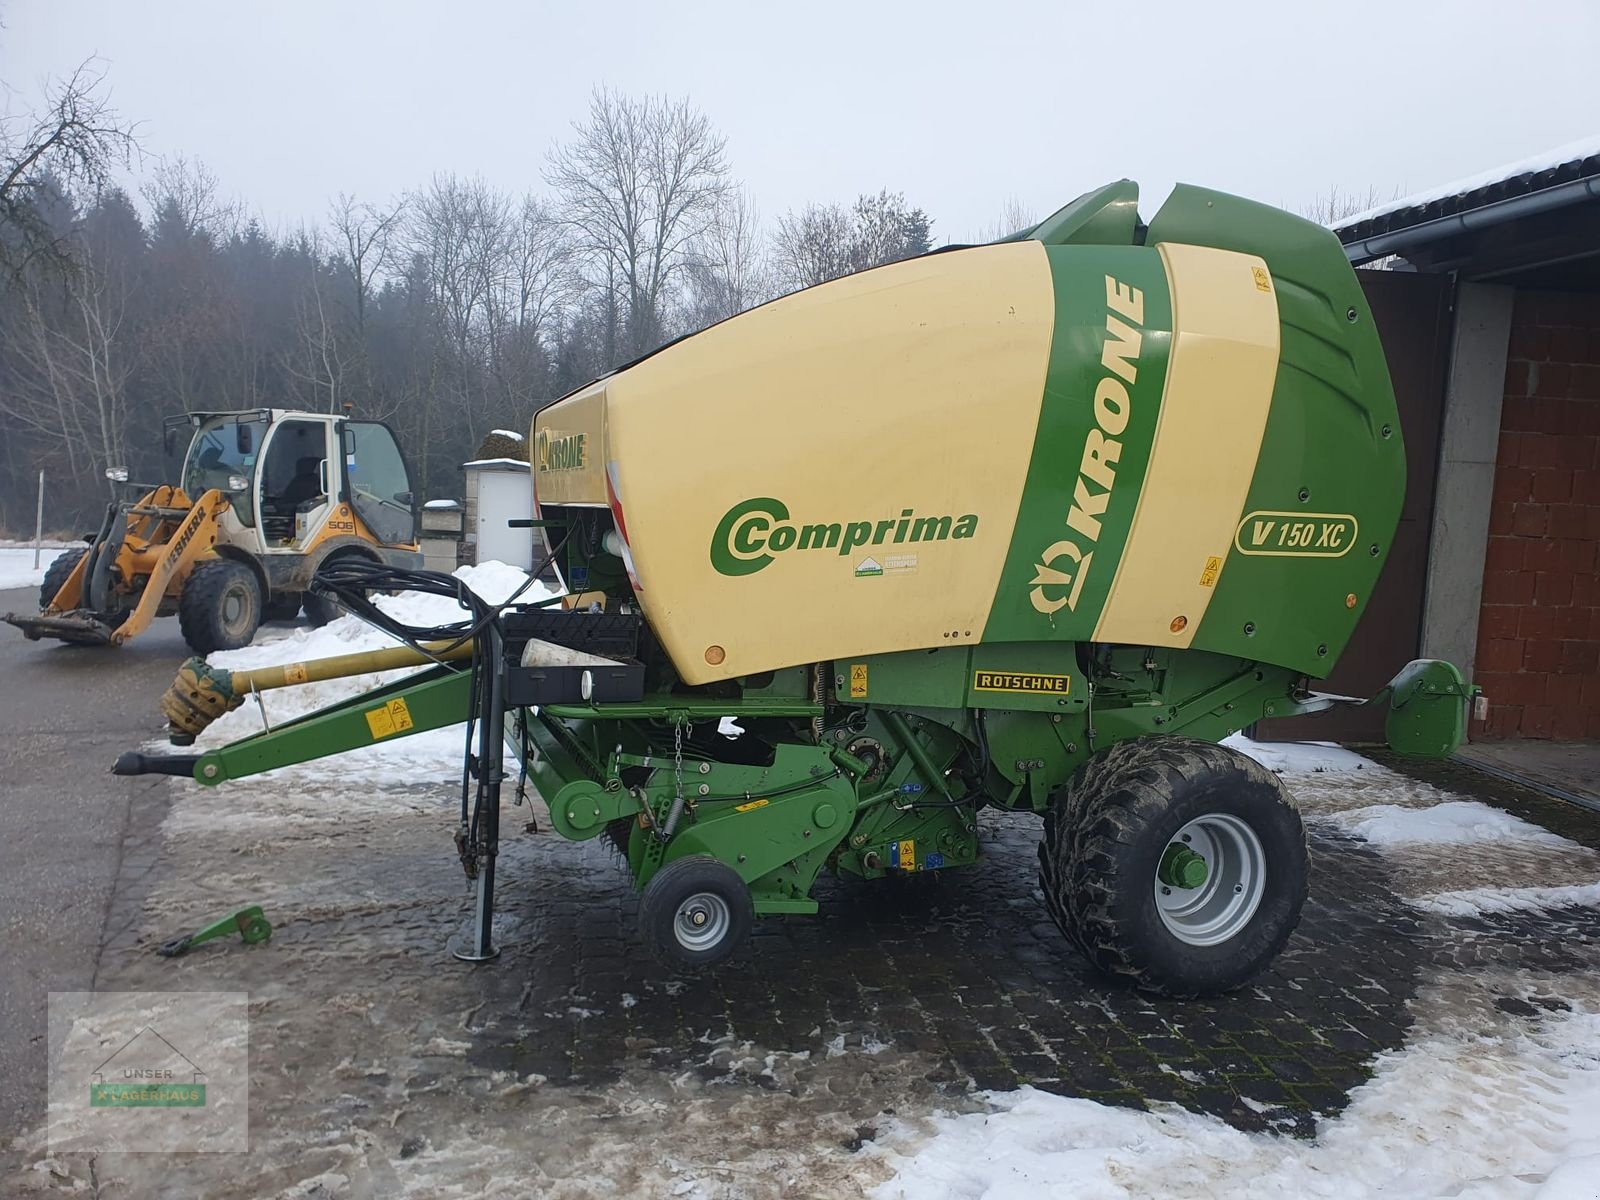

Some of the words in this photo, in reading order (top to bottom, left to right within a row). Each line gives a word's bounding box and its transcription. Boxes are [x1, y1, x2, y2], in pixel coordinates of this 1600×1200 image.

[1066, 274, 1144, 542] KRONE
[549, 434, 584, 470] KRONE
[162, 506, 206, 574] LIEBHERR
[328, 521, 353, 529] 506
[732, 507, 979, 557] Comprima
[1252, 521, 1276, 545] V
[1278, 523, 1315, 547] 150
[1315, 523, 1345, 547] XC
[981, 675, 1064, 690] ROTSCHNE
